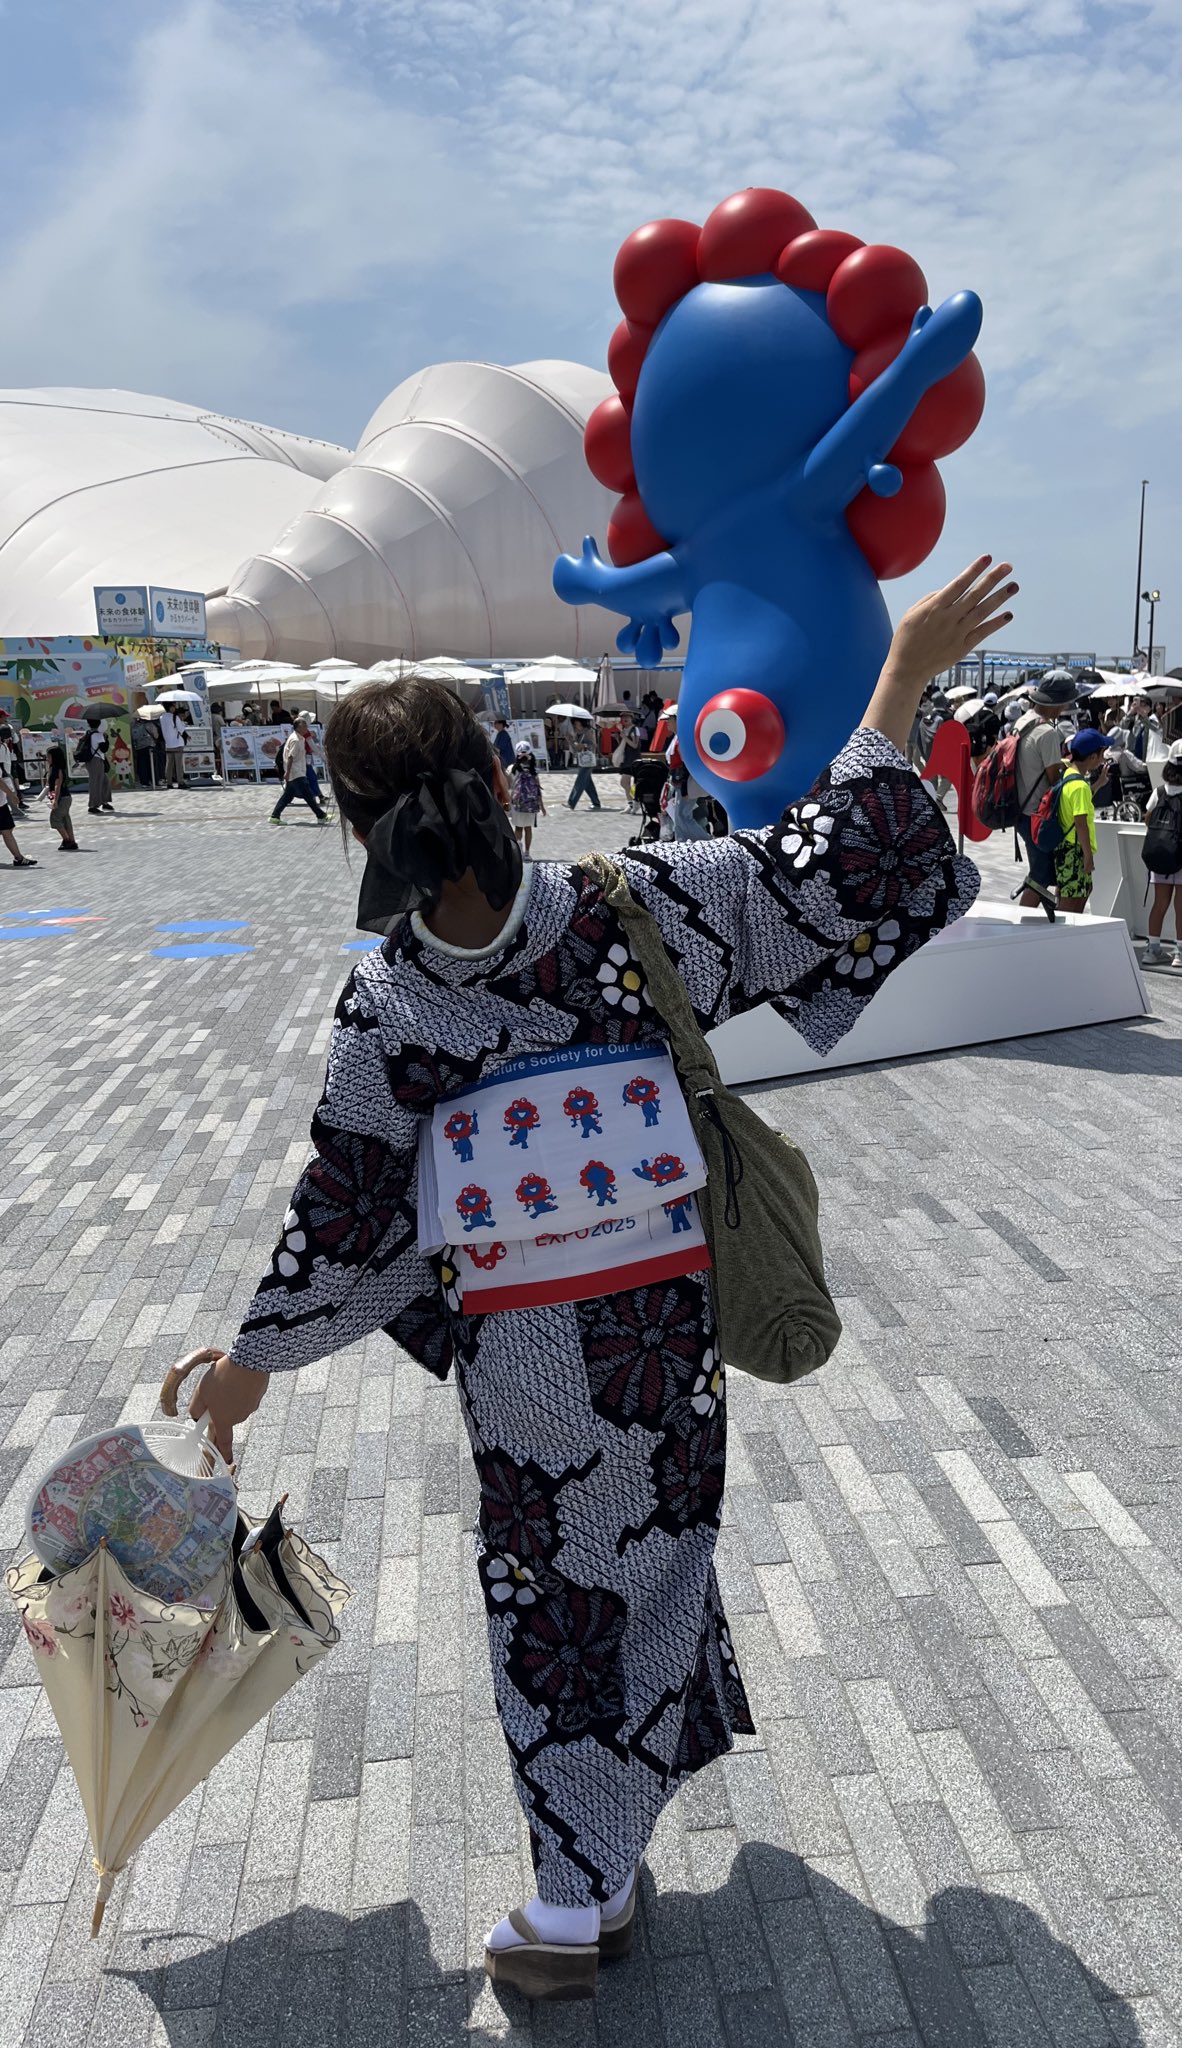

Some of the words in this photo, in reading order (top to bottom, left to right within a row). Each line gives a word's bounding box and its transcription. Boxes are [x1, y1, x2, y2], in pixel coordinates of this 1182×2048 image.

[99, 607, 146, 616] 未来の食体験
[486, 1060, 526, 1079] uture
[530, 1050, 581, 1067] Society
[585, 1047, 603, 1058] for
[608, 1043, 630, 1054] Our
